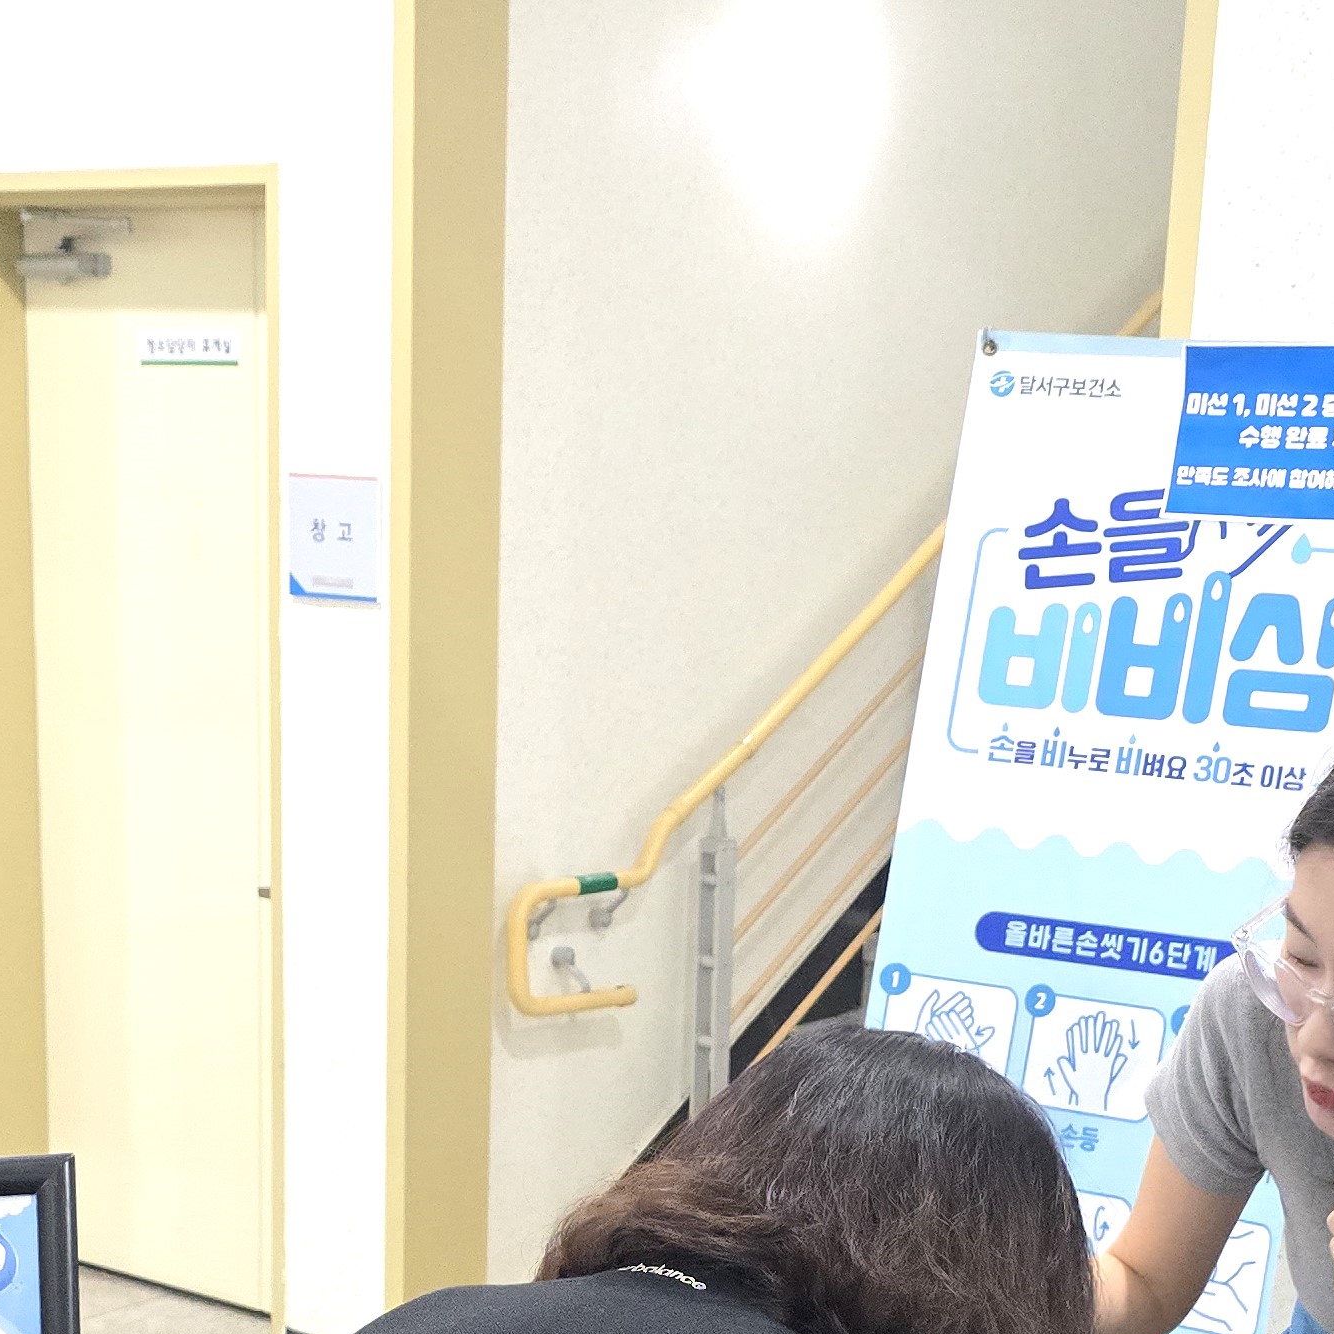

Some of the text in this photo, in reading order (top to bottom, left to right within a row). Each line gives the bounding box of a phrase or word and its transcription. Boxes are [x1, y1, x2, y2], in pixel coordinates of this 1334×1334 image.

[1019, 373, 1122, 399] 달서구보건소
[1186, 392, 1229, 417] 미션
[1232, 393, 1251, 418] 1,
[1255, 393, 1298, 417] 미션
[1301, 393, 1319, 417] 2
[1239, 425, 1282, 449] 수행
[1232, 467, 1287, 488] 조사에
[987, 733, 1307, 792] 손을 비누로 비벼요 30초 이상
[891, 970, 901, 988] 1
[1035, 992, 1048, 1010] 2
